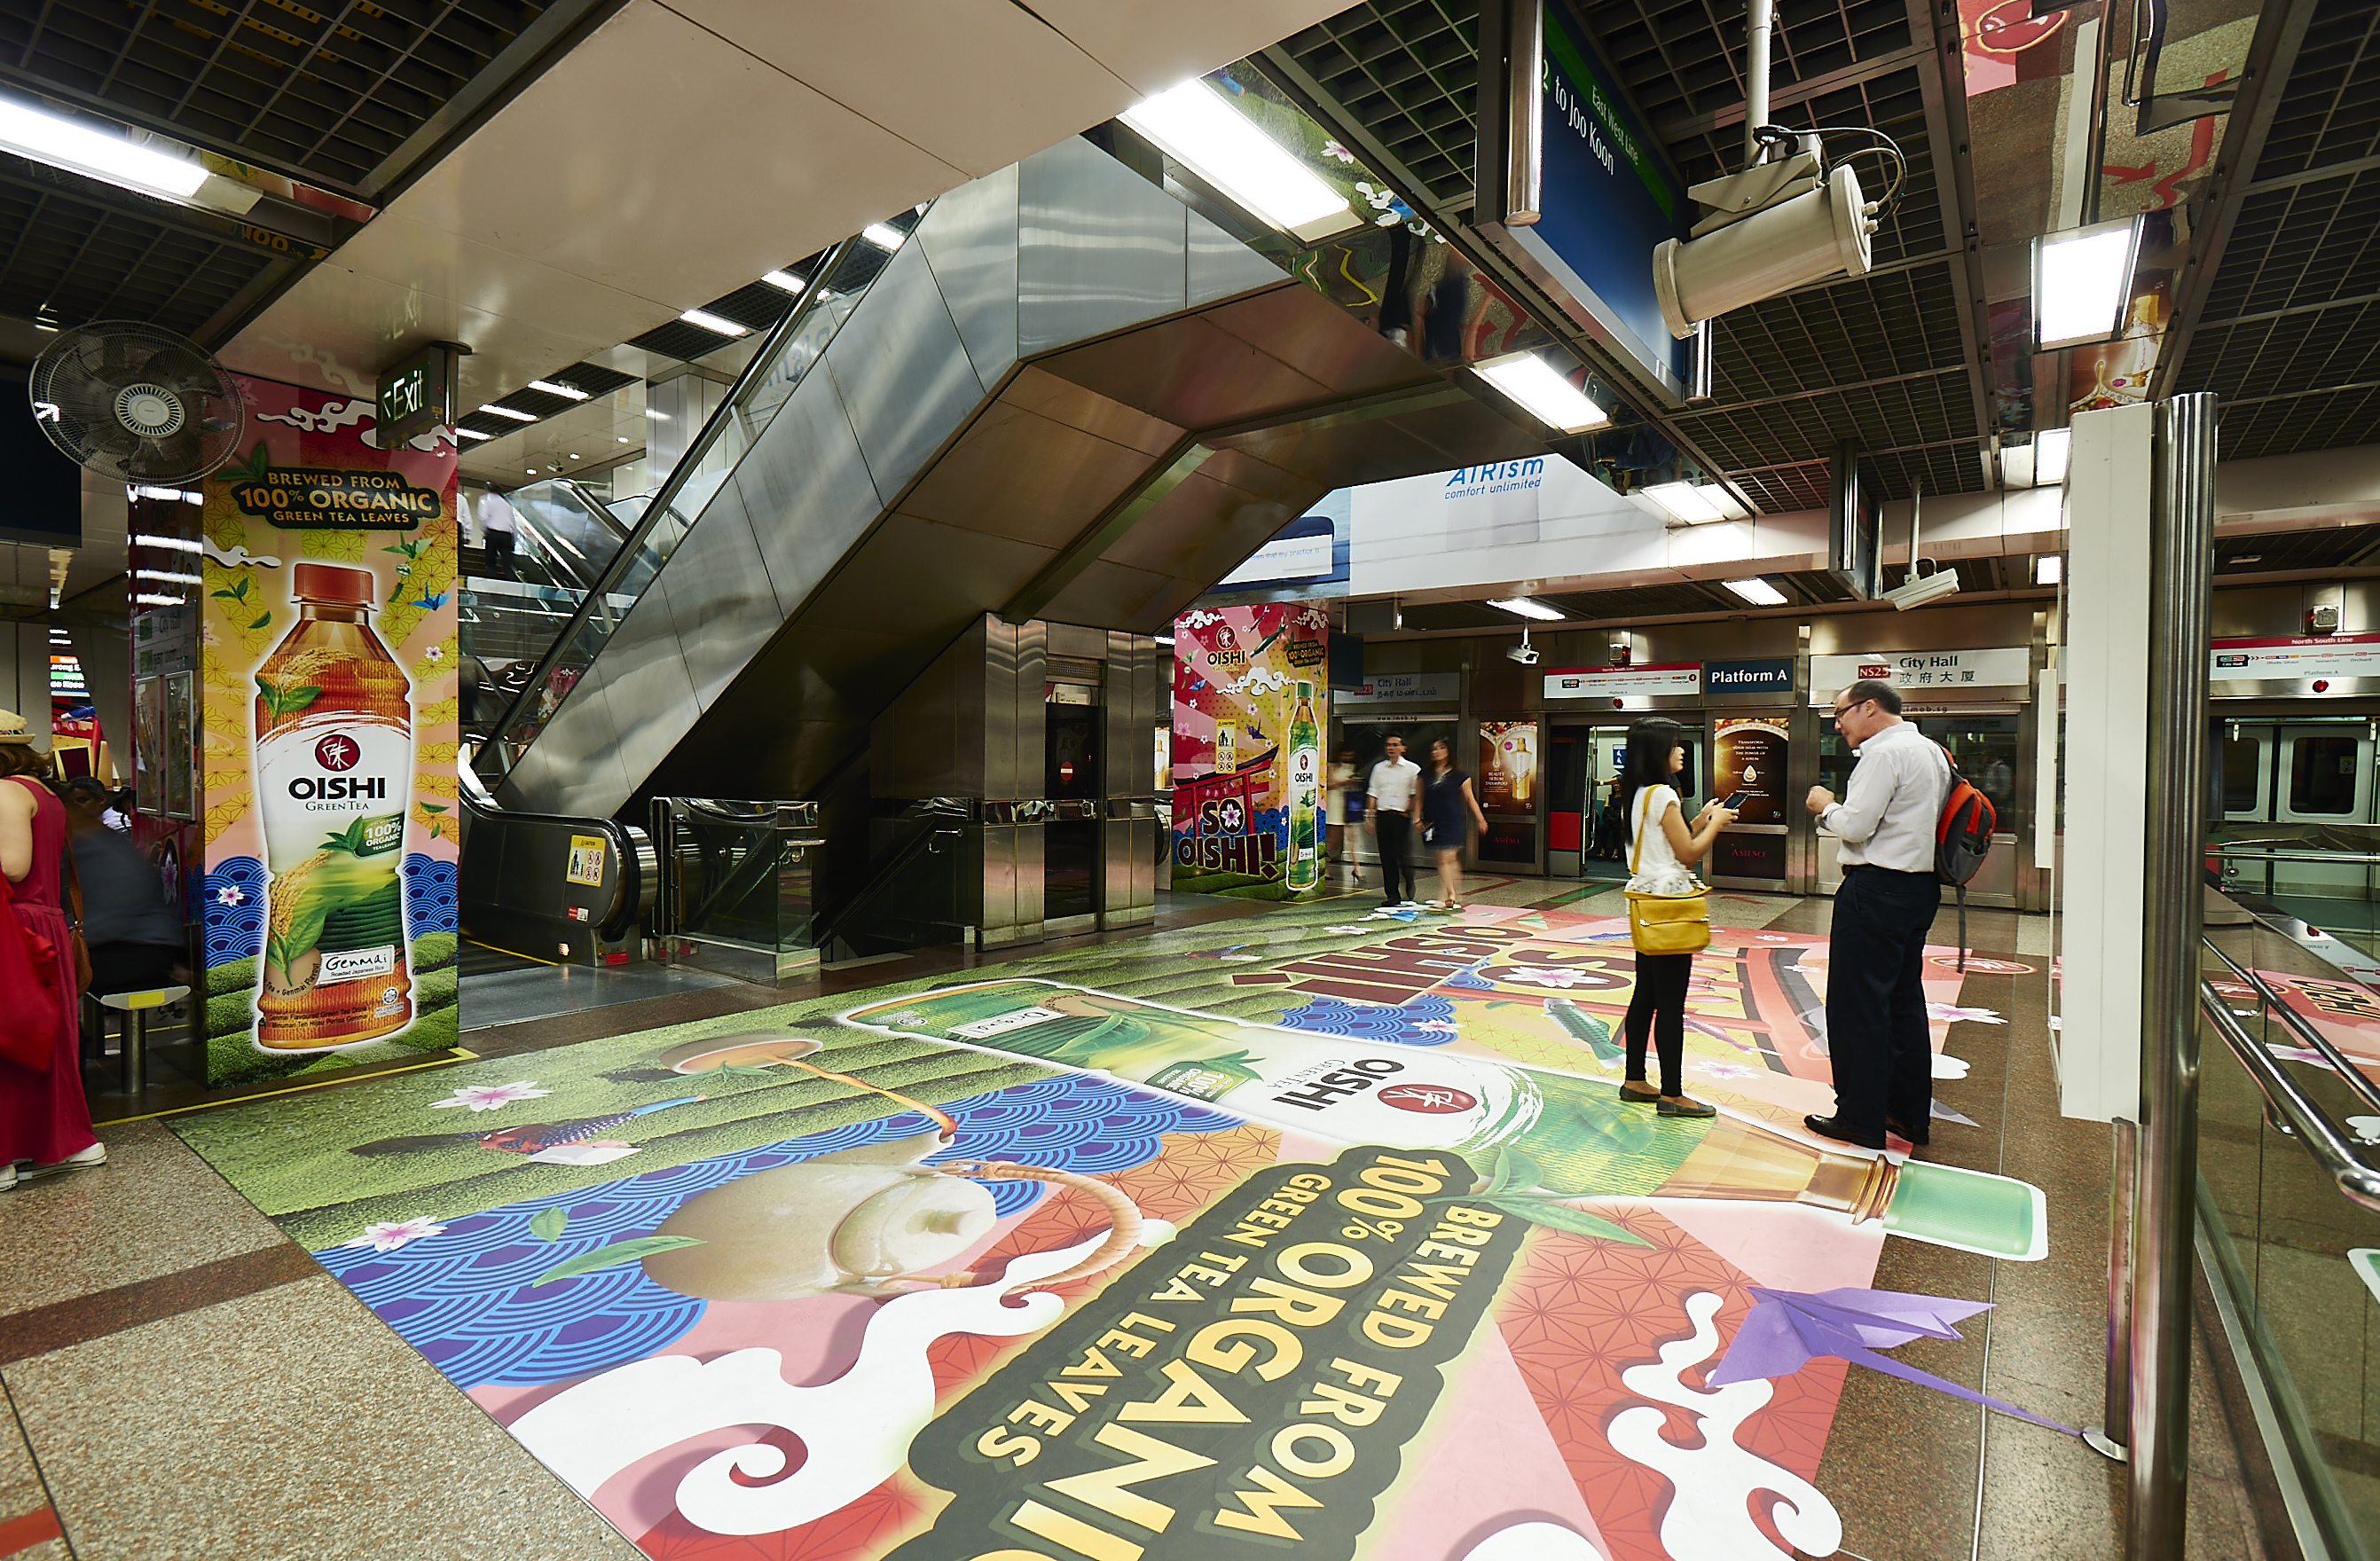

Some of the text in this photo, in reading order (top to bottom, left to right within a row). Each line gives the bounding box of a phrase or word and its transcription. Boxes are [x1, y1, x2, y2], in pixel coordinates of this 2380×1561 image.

[1555, 75, 1567, 111] to
[1568, 94, 1587, 138] Joo
[1589, 121, 1614, 176] Koon
[1592, 84, 1638, 166] East West Line
[393, 369, 424, 421] Exit
[268, 472, 400, 489] BREWED FROM
[1444, 477, 1542, 499] comfort unlimited
[240, 487, 433, 512] 100% ORGANIC
[273, 510, 410, 523] GREEN TEA LEAVES
[1206, 650, 1246, 665] OISHI
[1899, 655, 1958, 670] City Hall
[1378, 678, 1412, 688] City Hall
[1711, 669, 1787, 685] Platform A
[1859, 667, 1890, 678] NS25
[1899, 670, 1975, 685] 政府大厦
[287, 777, 386, 800] OISHI
[1294, 773, 1314, 782] OISHI
[1201, 797, 1245, 836] SO
[365, 820, 402, 839] 100%
[365, 833, 400, 847] ORGANIC
[1176, 832, 1279, 881] OISHI!
[1732, 849, 1767, 858] ASIENCE
[326, 953, 388, 971] Genmai
[281, 981, 307, 996] Genmai
[304, 962, 320, 985] Flavour
[1178, 1071, 1225, 1096] 100%
[1271, 1059, 1405, 1111] OISHI
[1335, 1153, 1456, 1243] 100%
[976, 1172, 1332, 1468] GREEN TEA LEAVES
[1213, 1205, 1505, 1542] BREWED FROM
[969, 1242, 1375, 1561] ORGANI
